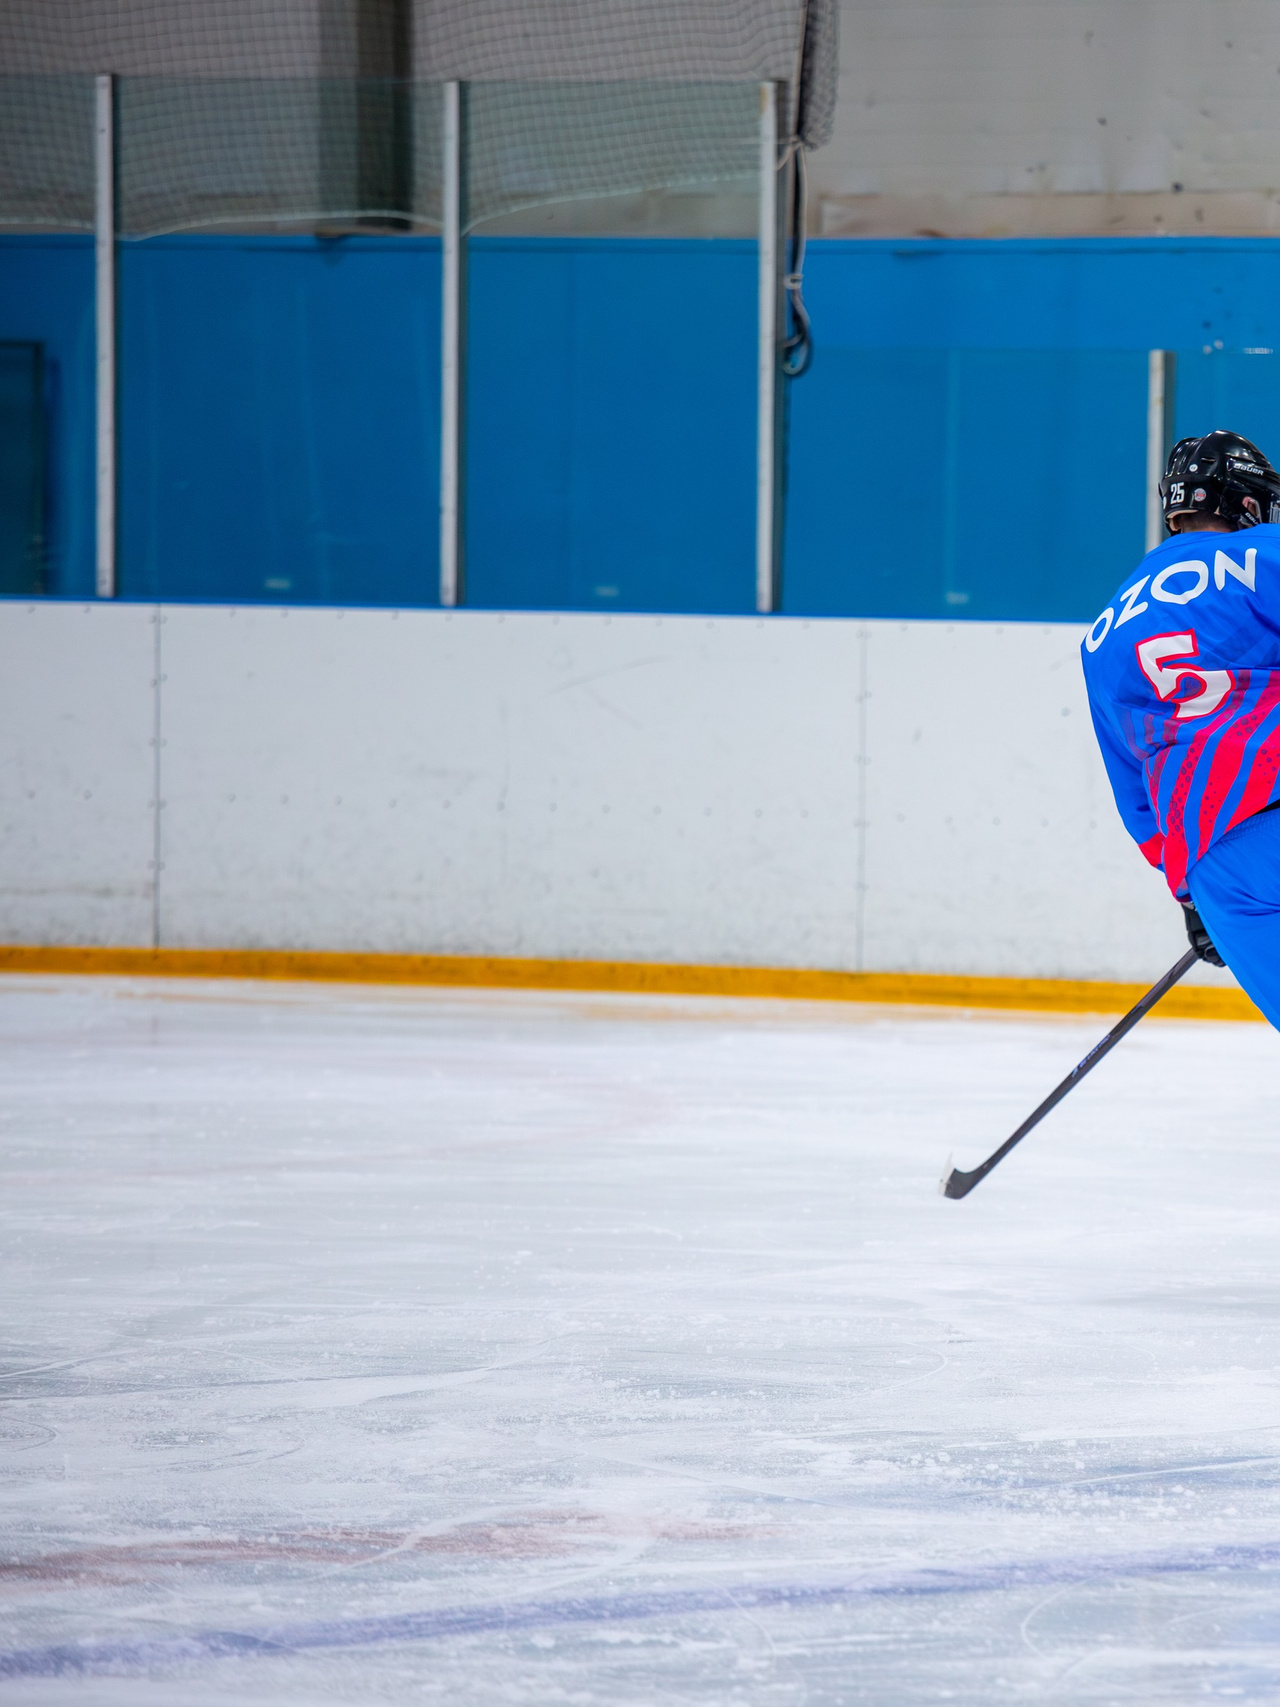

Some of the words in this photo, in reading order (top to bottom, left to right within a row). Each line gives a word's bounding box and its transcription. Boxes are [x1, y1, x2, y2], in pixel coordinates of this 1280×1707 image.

[1233, 463, 1264, 476] BAUER
[1170, 482, 1185, 504] 25
[1245, 512, 1259, 525] BAU
[1085, 548, 1257, 653] OZON
[1136, 628, 1236, 720] 5
